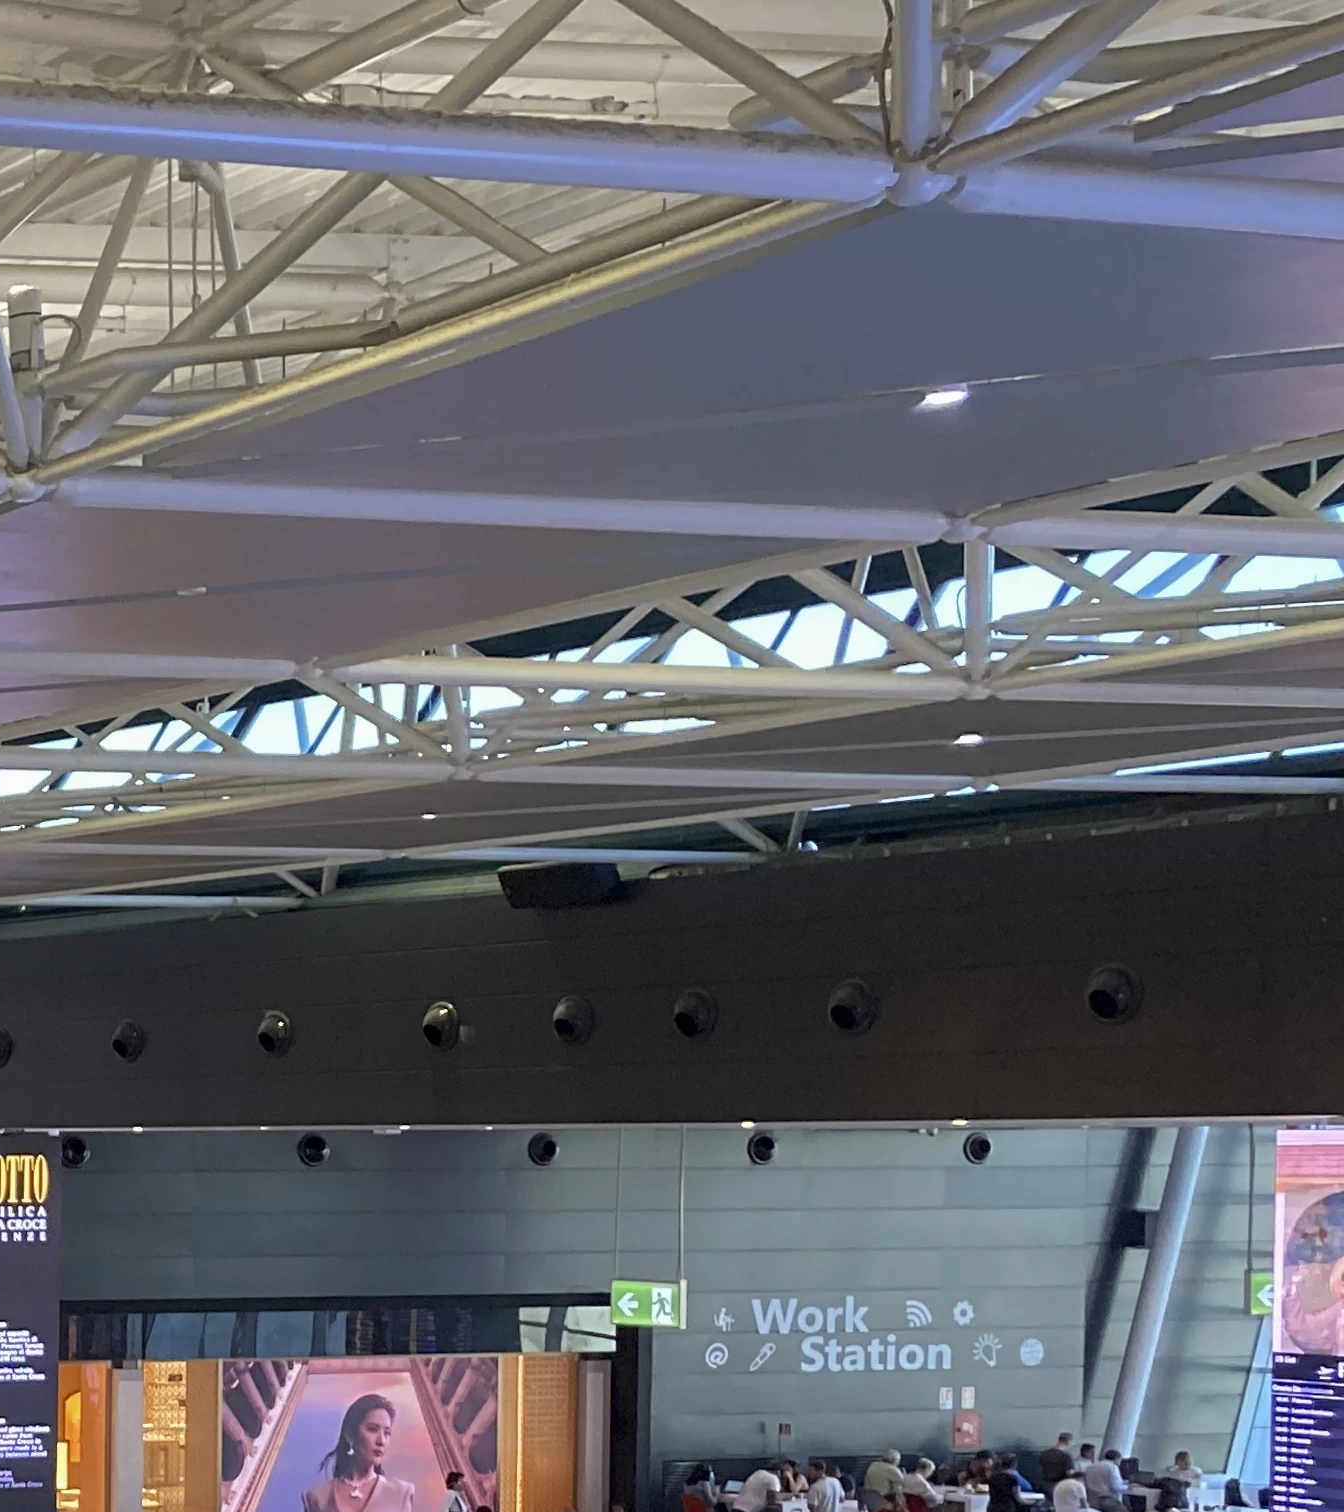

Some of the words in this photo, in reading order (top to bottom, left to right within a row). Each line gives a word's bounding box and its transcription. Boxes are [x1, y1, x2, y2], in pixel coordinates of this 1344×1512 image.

[6, 1219, 47, 1231] CROCE
[751, 1295, 869, 1335] Work
[800, 1333, 952, 1372] Station
